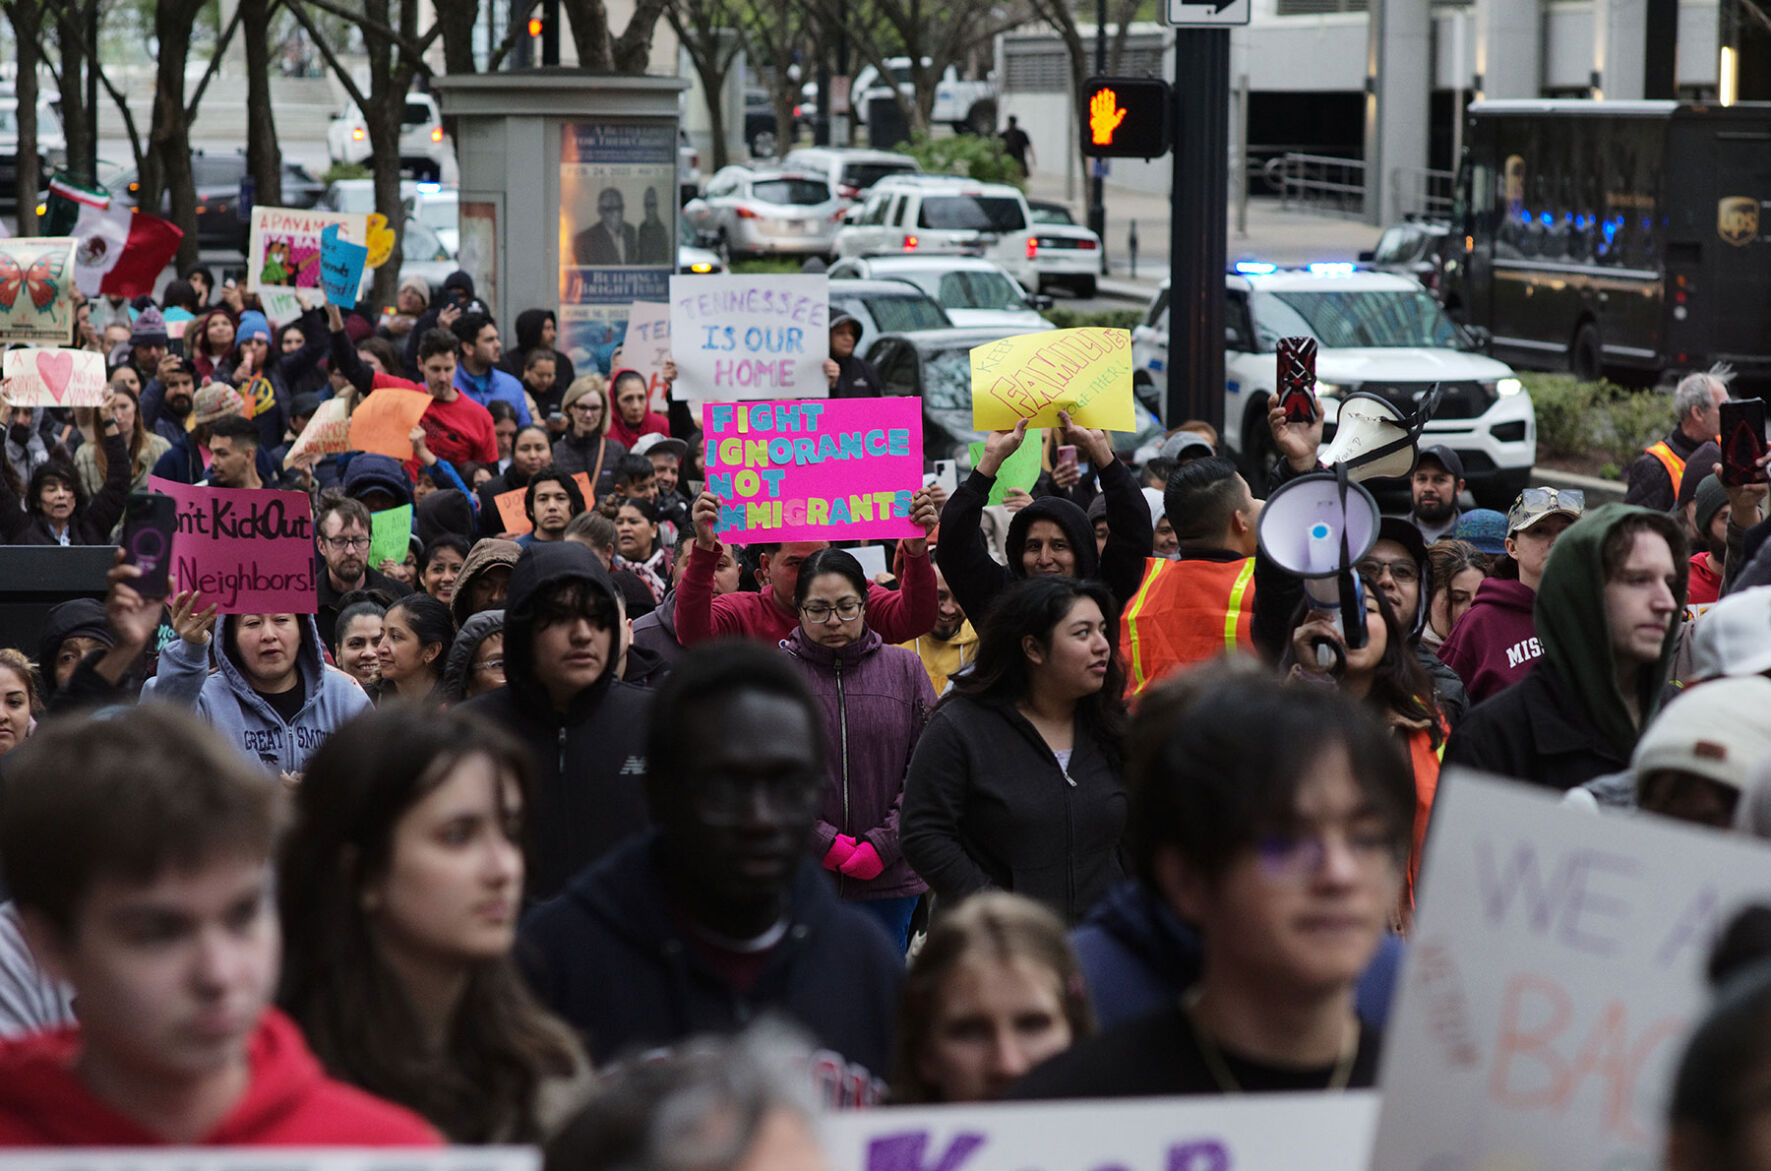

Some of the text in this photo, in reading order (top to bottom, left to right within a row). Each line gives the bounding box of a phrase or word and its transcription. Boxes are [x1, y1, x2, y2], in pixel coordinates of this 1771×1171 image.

[680, 288, 826, 327] TENNESSEE
[701, 325, 804, 354] IS OUR
[976, 339, 1014, 373] KEEP
[715, 359, 796, 388] HOME
[712, 403, 824, 434] FIGHT
[705, 429, 910, 468] IGNORANCE
[708, 469, 786, 500] NOT
[178, 555, 316, 609] Neighbors!
[1506, 636, 1546, 669] MIS
[244, 727, 283, 751] GREAT
[1471, 836, 1647, 957] WE
